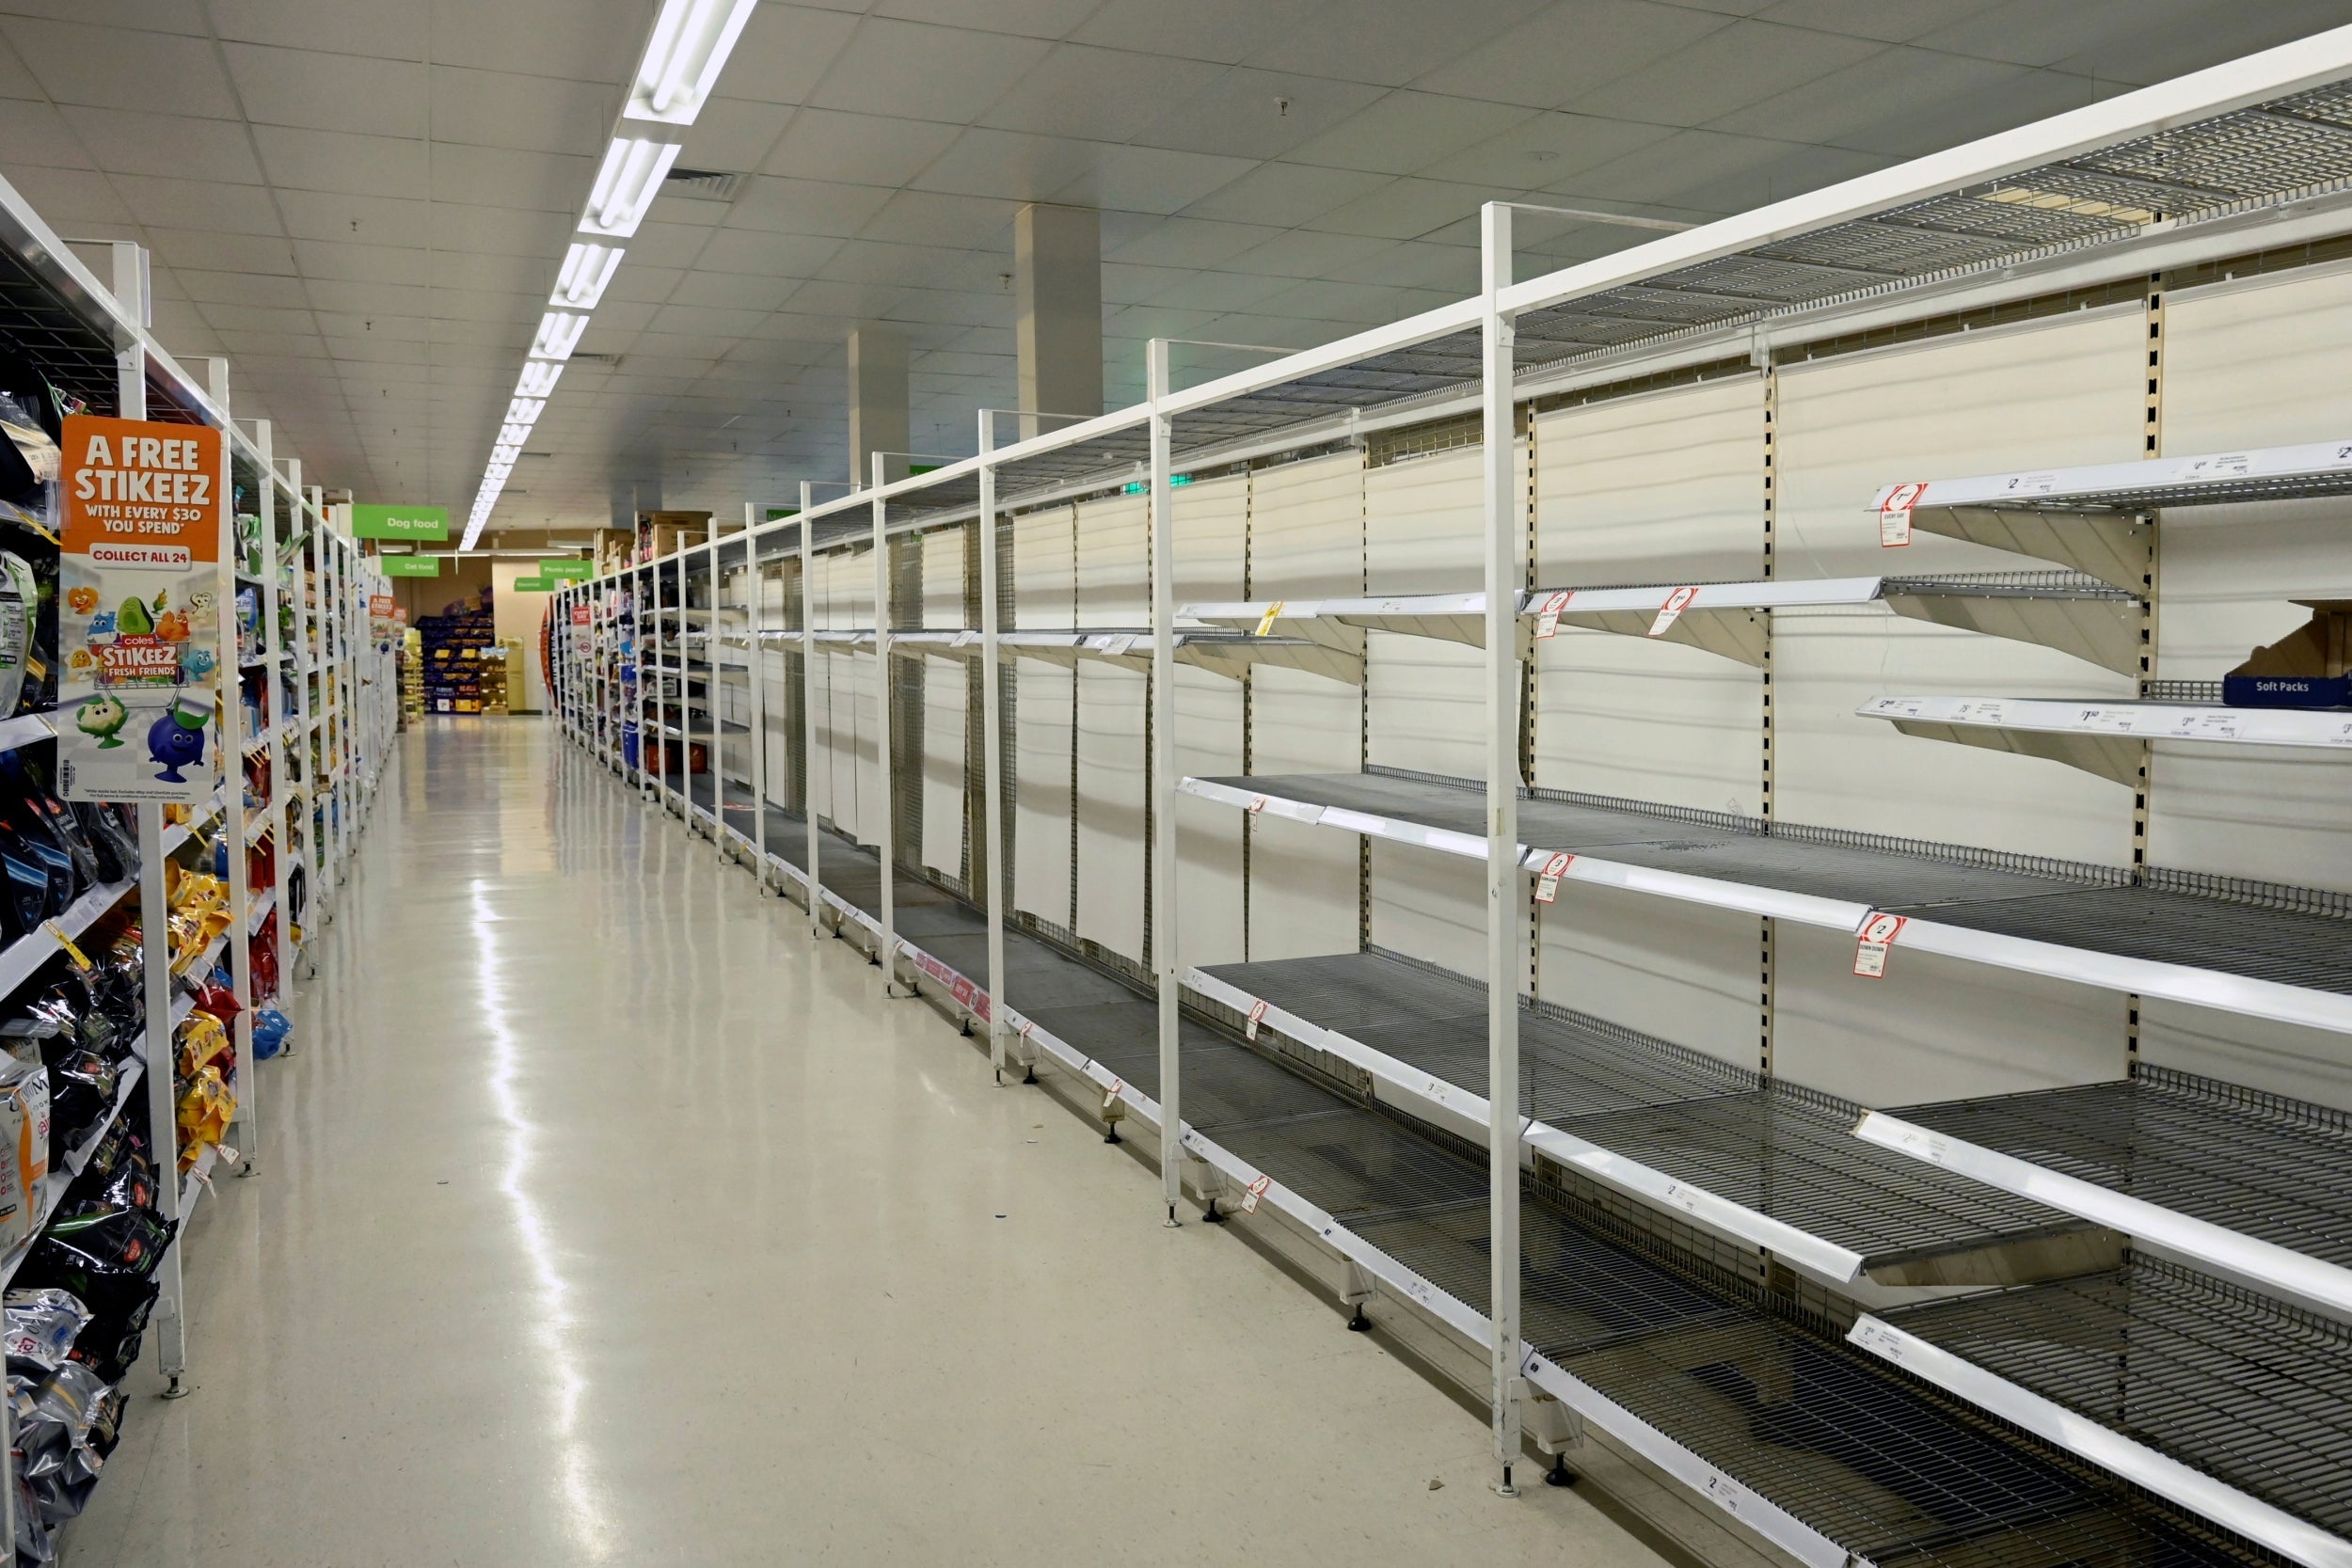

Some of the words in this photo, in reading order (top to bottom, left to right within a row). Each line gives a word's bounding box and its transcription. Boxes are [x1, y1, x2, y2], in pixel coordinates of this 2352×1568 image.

[85, 435, 114, 467] A
[122, 436, 199, 471] FREE
[74, 468, 211, 505] STIKEEZ
[85, 504, 121, 517] WITH
[125, 505, 168, 520] EVERY
[172, 506, 201, 522] $30
[103, 519, 134, 532] YOU
[387, 517, 410, 530] Dog
[413, 519, 439, 529] food
[92, 549, 148, 562] COLLECT
[150, 551, 169, 562] ALL
[172, 552, 187, 563] 24
[124, 636, 154, 645] coles
[108, 668, 136, 677] FRESH
[138, 666, 176, 676] FRIENDS
[2256, 681, 2278, 692] Soft
[2280, 682, 2310, 692] Packs
